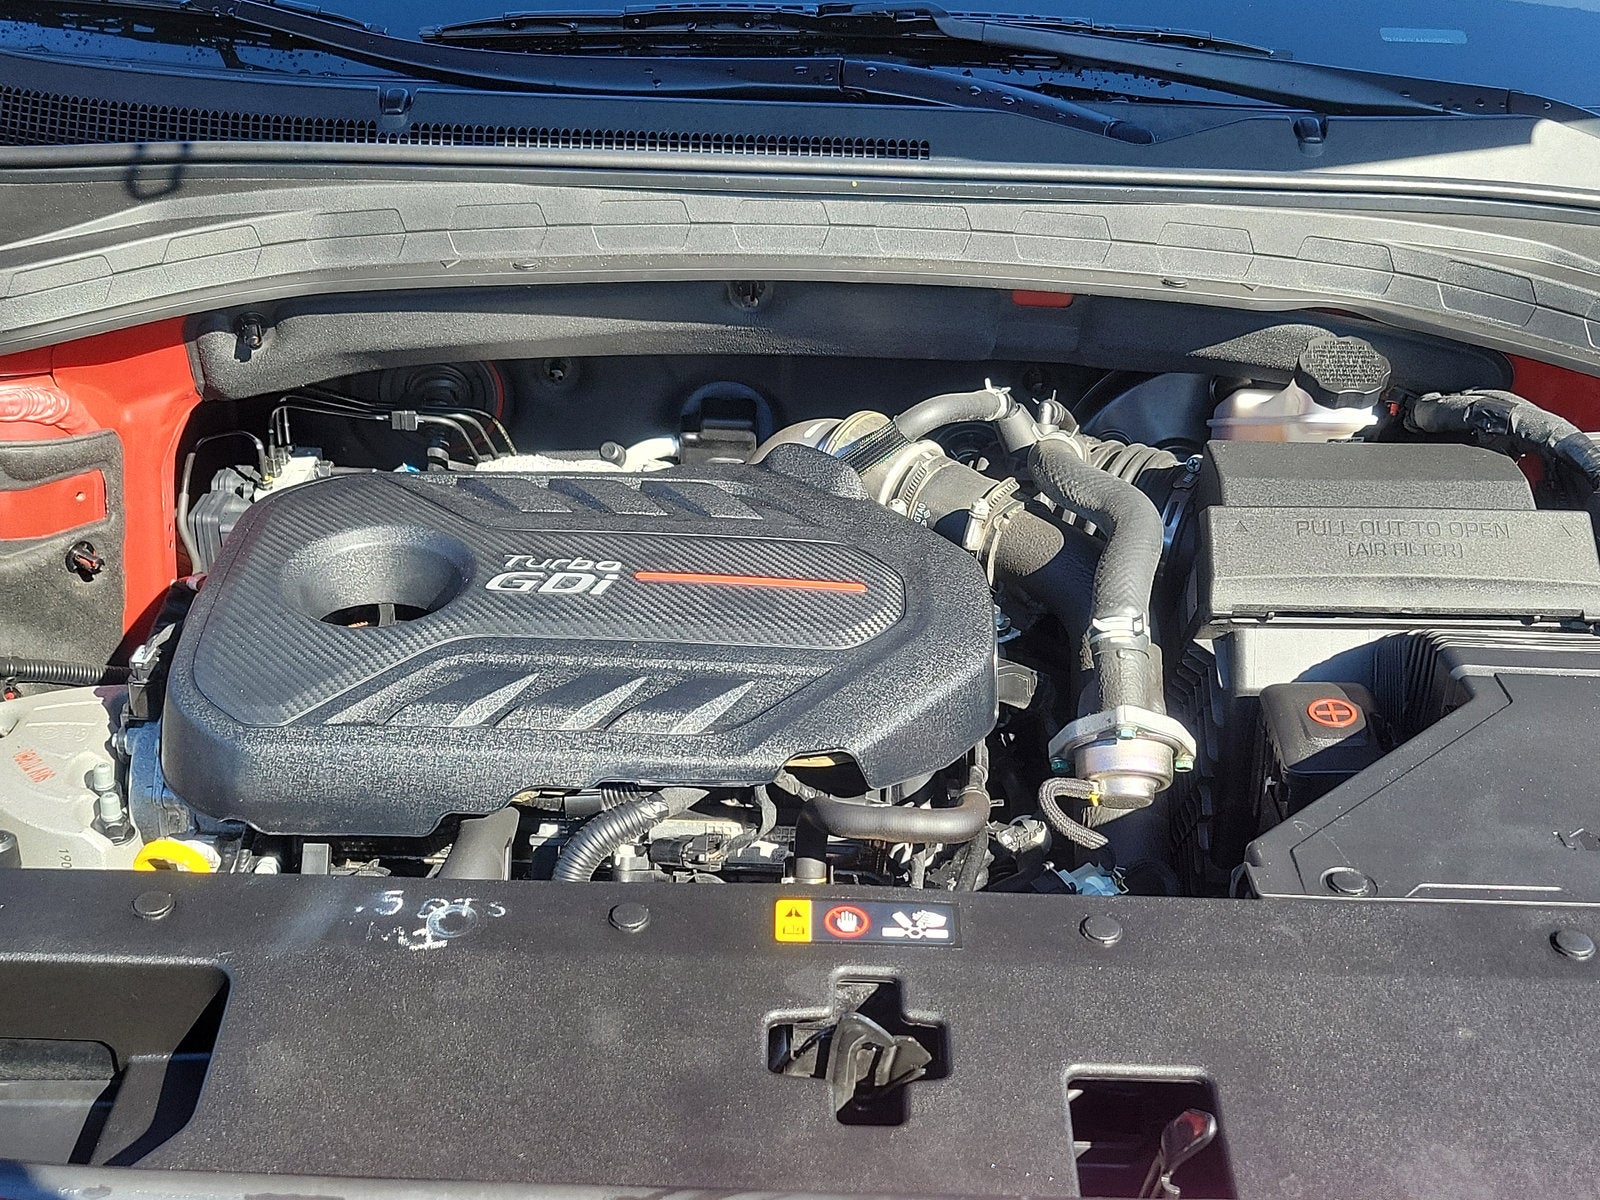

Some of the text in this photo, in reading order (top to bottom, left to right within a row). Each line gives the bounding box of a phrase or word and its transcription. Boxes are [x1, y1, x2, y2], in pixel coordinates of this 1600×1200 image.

[1295, 519, 1510, 539] PULL OUT TO OPEN
[504, 554, 622, 571] Turbo
[485, 571, 619, 595] GDi
[59, 849, 72, 868] 190
